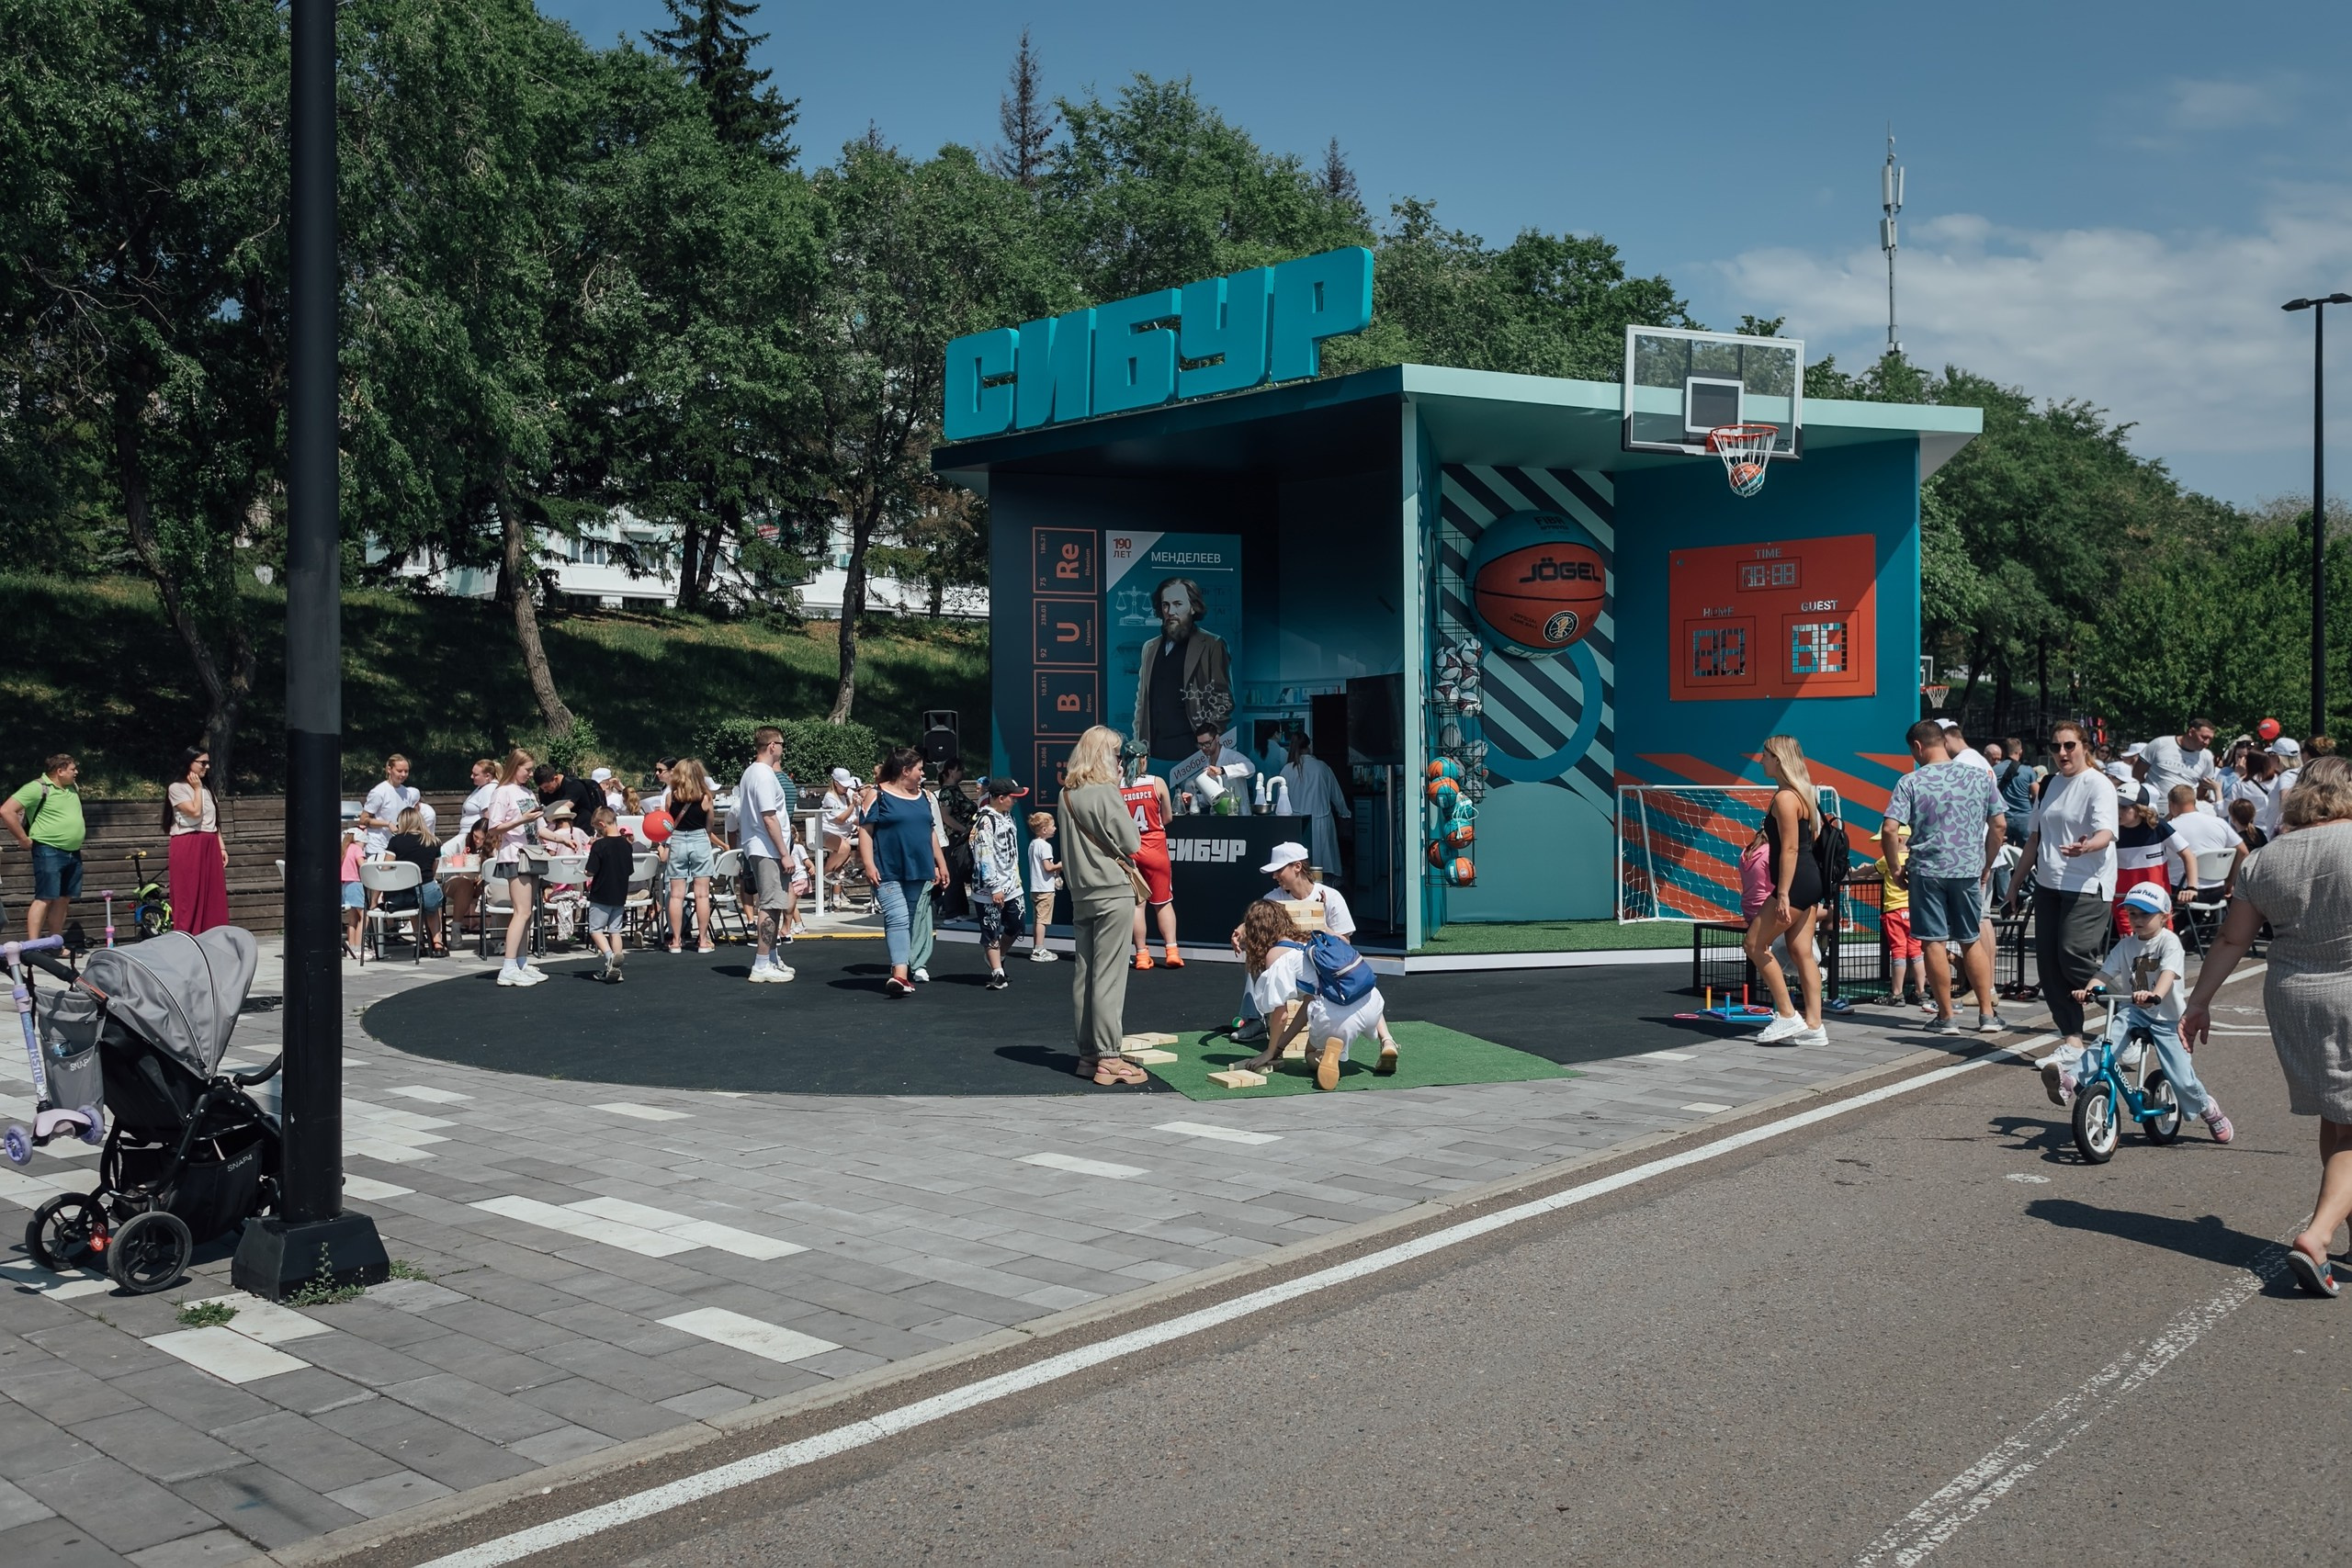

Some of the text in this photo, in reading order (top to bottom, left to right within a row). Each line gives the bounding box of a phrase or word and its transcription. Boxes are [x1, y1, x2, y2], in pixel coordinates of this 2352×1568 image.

[944, 245, 1374, 441] СИБУР
[1533, 515, 1566, 525] FIBA
[1113, 538, 1132, 548] 190
[1113, 550, 1132, 558] ЛЕТ
[1150, 551, 1221, 564] МЕНДЕЛЕЕВ
[1755, 548, 1782, 558] TIME
[1056, 543, 1080, 579] Re
[1519, 557, 1601, 583] JÖGEL
[1040, 577, 1046, 587] 75
[1702, 606, 1735, 617] HOME
[1801, 599, 1838, 612] GUEST
[1057, 621, 1080, 642] U
[1040, 648, 1047, 659] 92
[1057, 694, 1080, 712] B
[1041, 790, 1047, 799] 14
[1124, 791, 1152, 802] СНОЯРСК
[1166, 839, 1247, 863] СИБУР
[30, 1050, 45, 1084] RUSH
[227, 1154, 253, 1172] SNAP4
